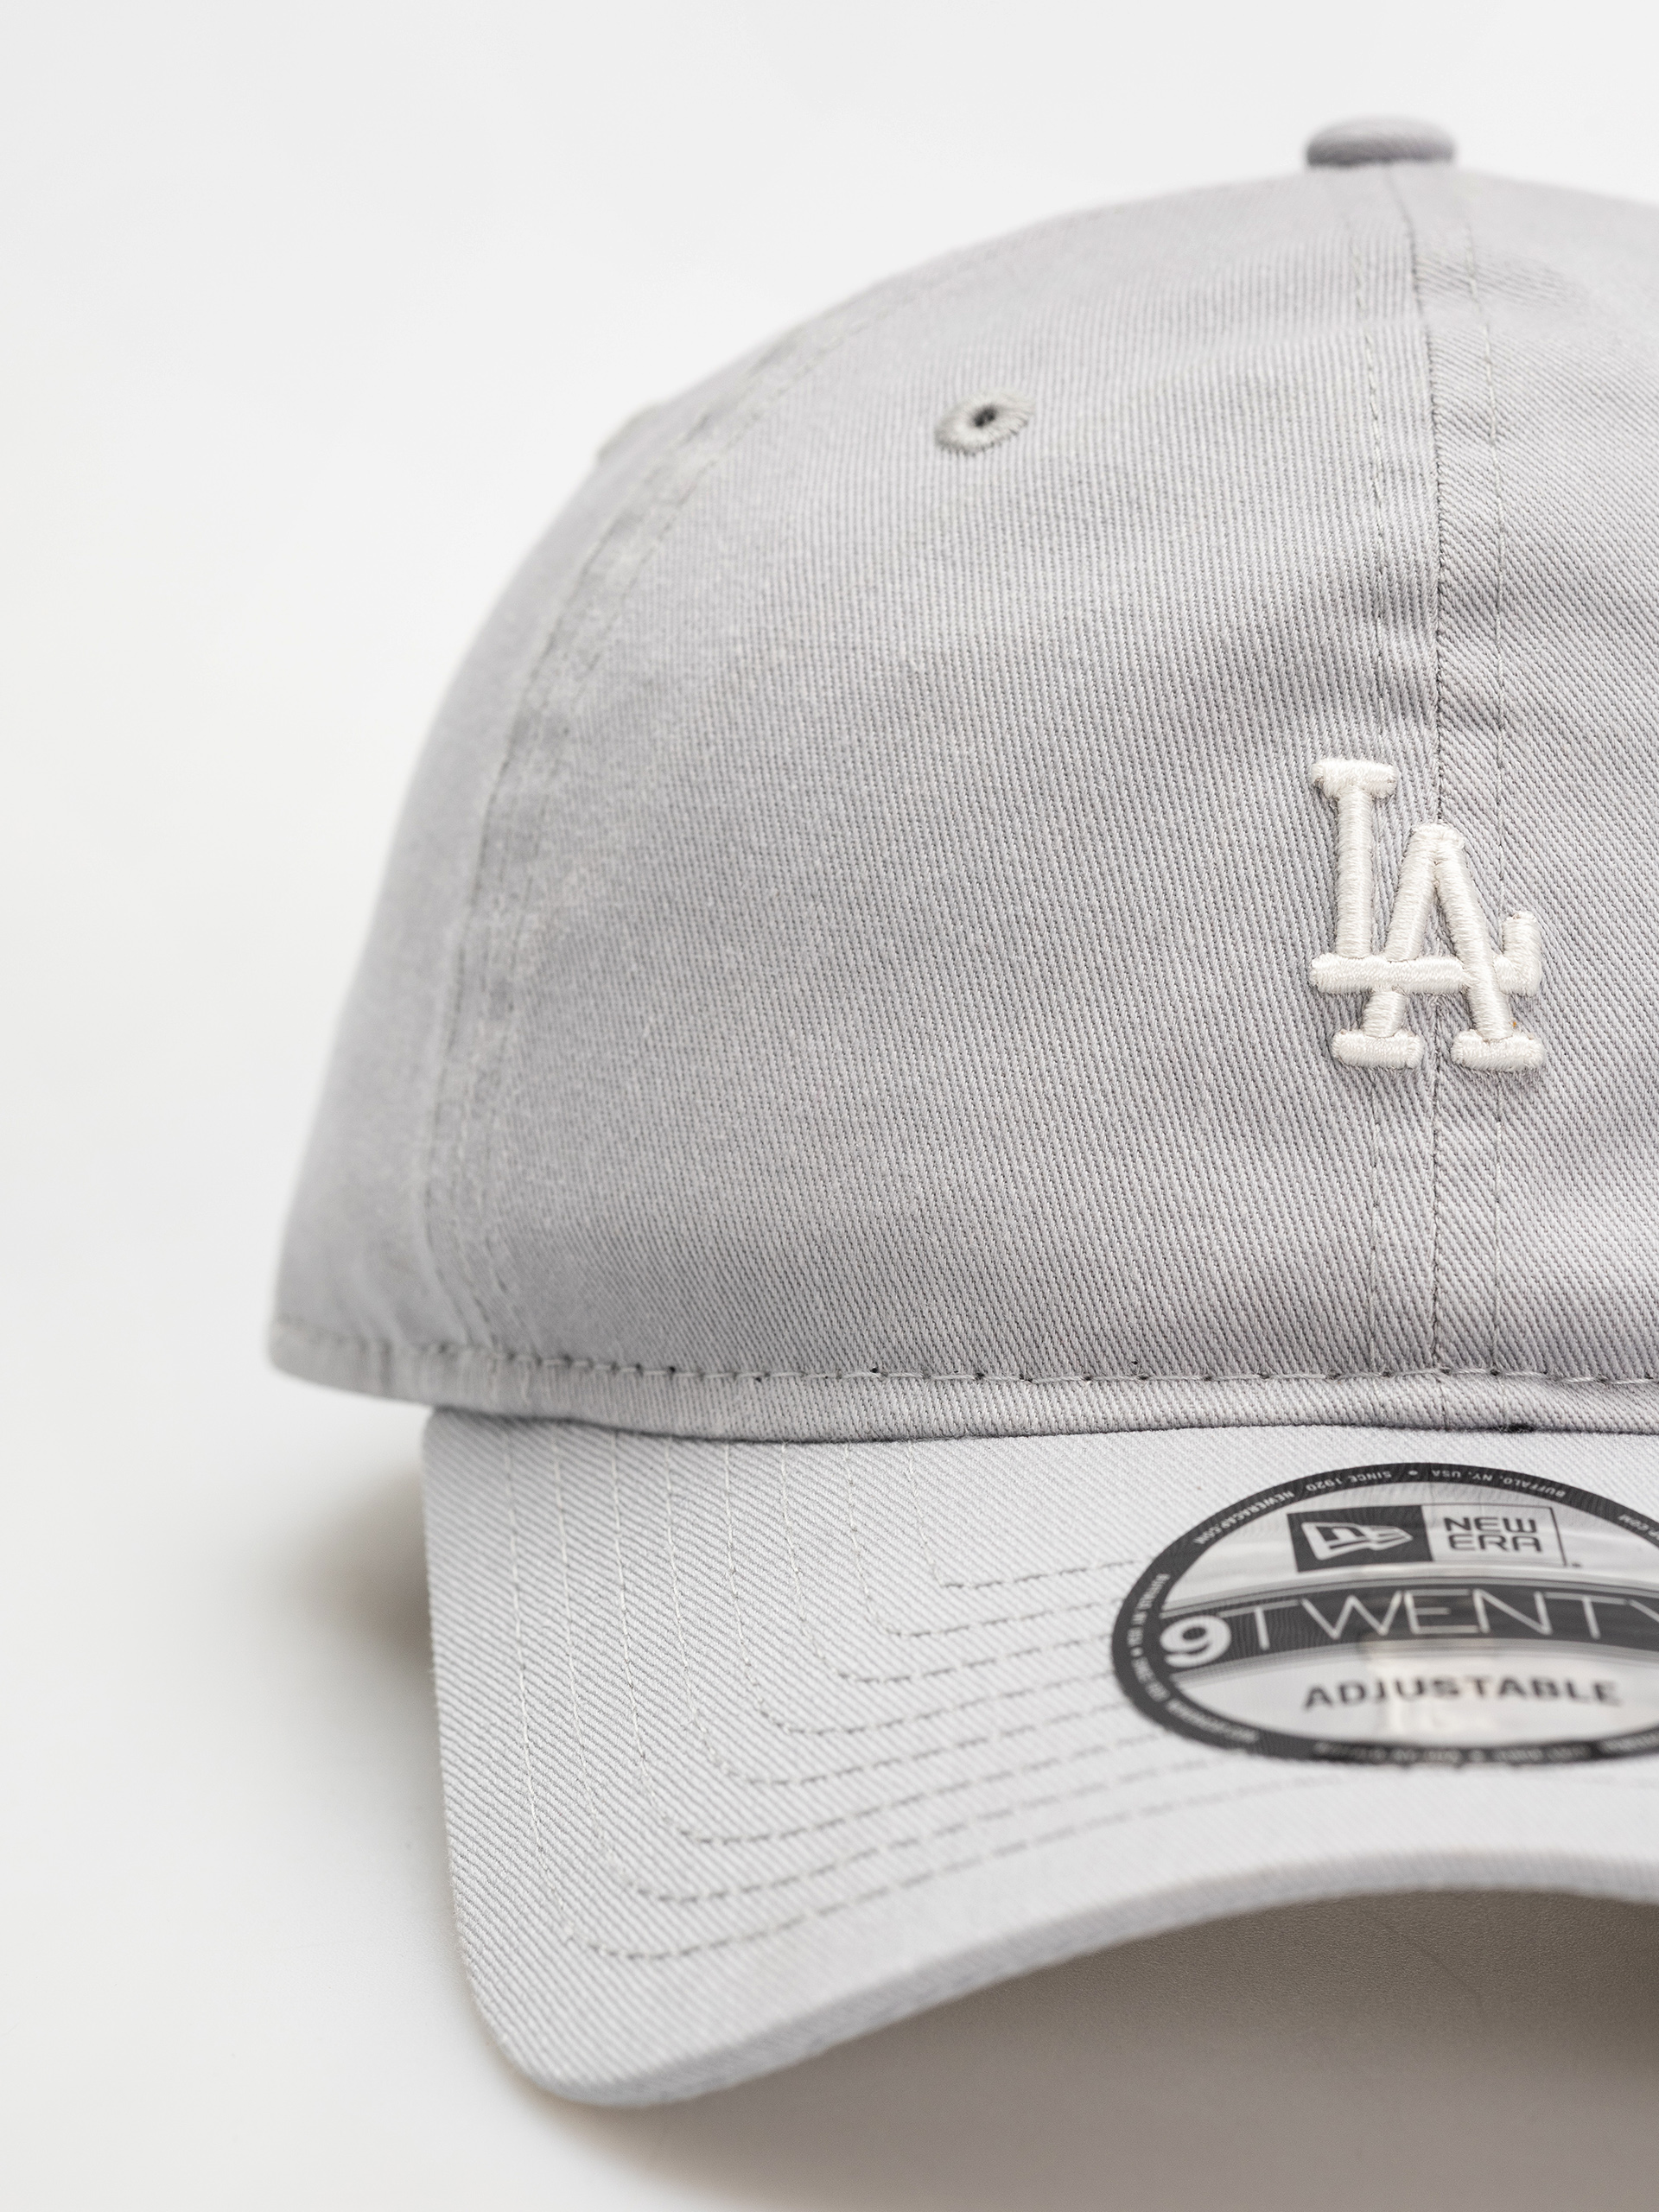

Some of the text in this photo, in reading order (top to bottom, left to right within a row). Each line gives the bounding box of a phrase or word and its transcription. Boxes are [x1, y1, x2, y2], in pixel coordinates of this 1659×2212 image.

[1310, 757, 1545, 1071] LA
[1347, 1470, 1393, 1484] SINCE
[1431, 1469, 1462, 1478] USA
[1305, 1476, 1344, 1493] 1920
[1443, 1515, 1538, 1534] NEW
[1447, 1533, 1543, 1553] ERA
[1303, 1675, 1623, 1711] ADJUSTABLE
